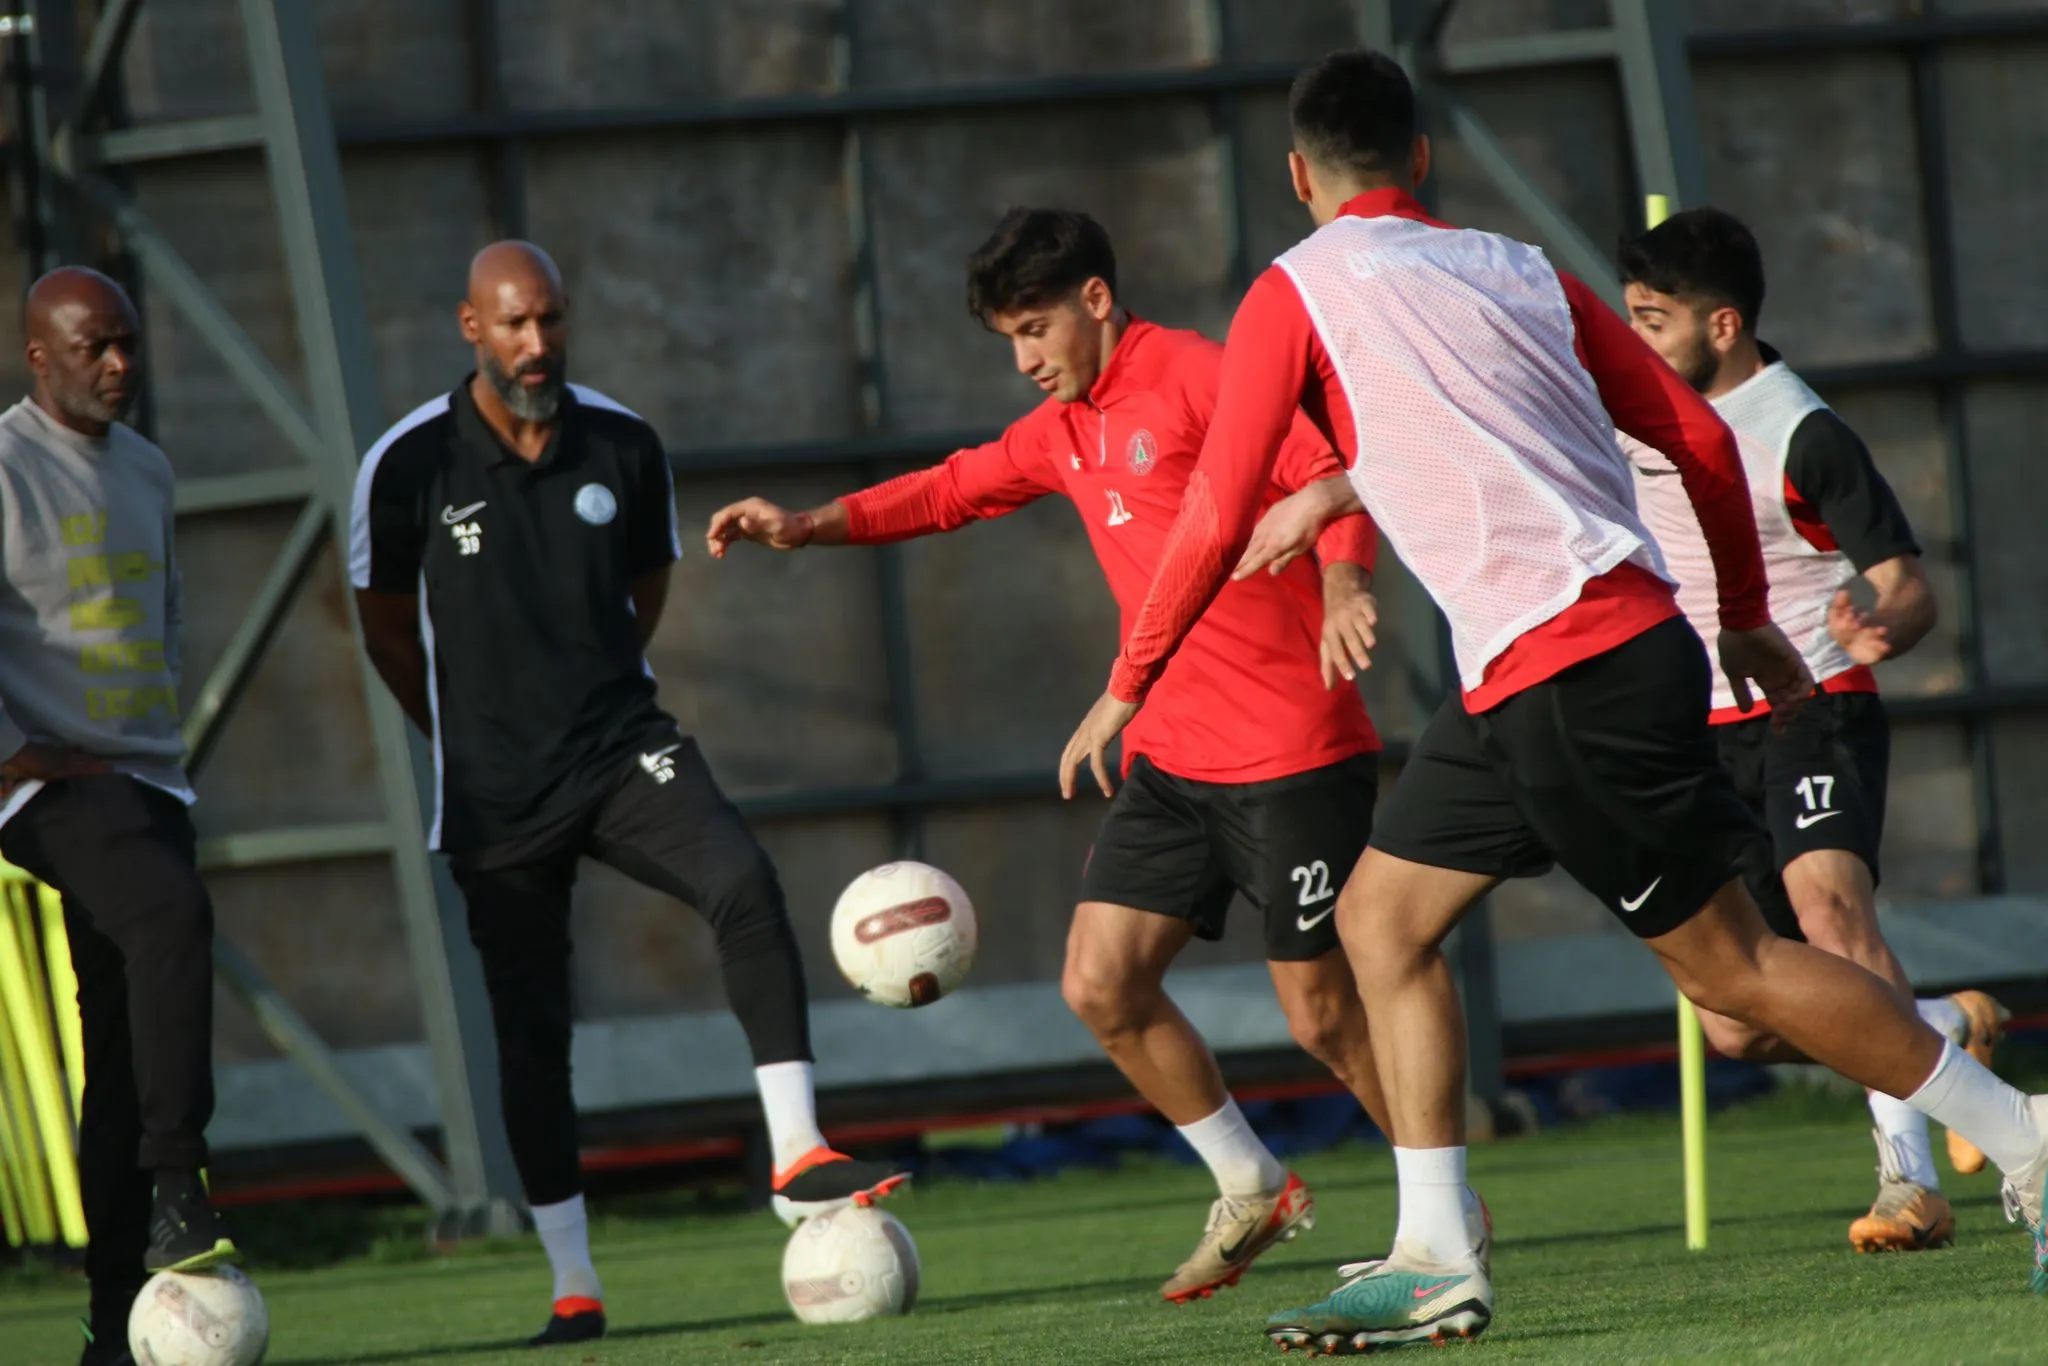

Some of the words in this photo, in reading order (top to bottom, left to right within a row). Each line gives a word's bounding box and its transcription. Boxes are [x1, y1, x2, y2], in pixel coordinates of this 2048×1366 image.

[458, 535, 481, 556] 39
[655, 766, 676, 785] 39
[1795, 775, 1835, 810] 17
[1291, 860, 1335, 906] 22
